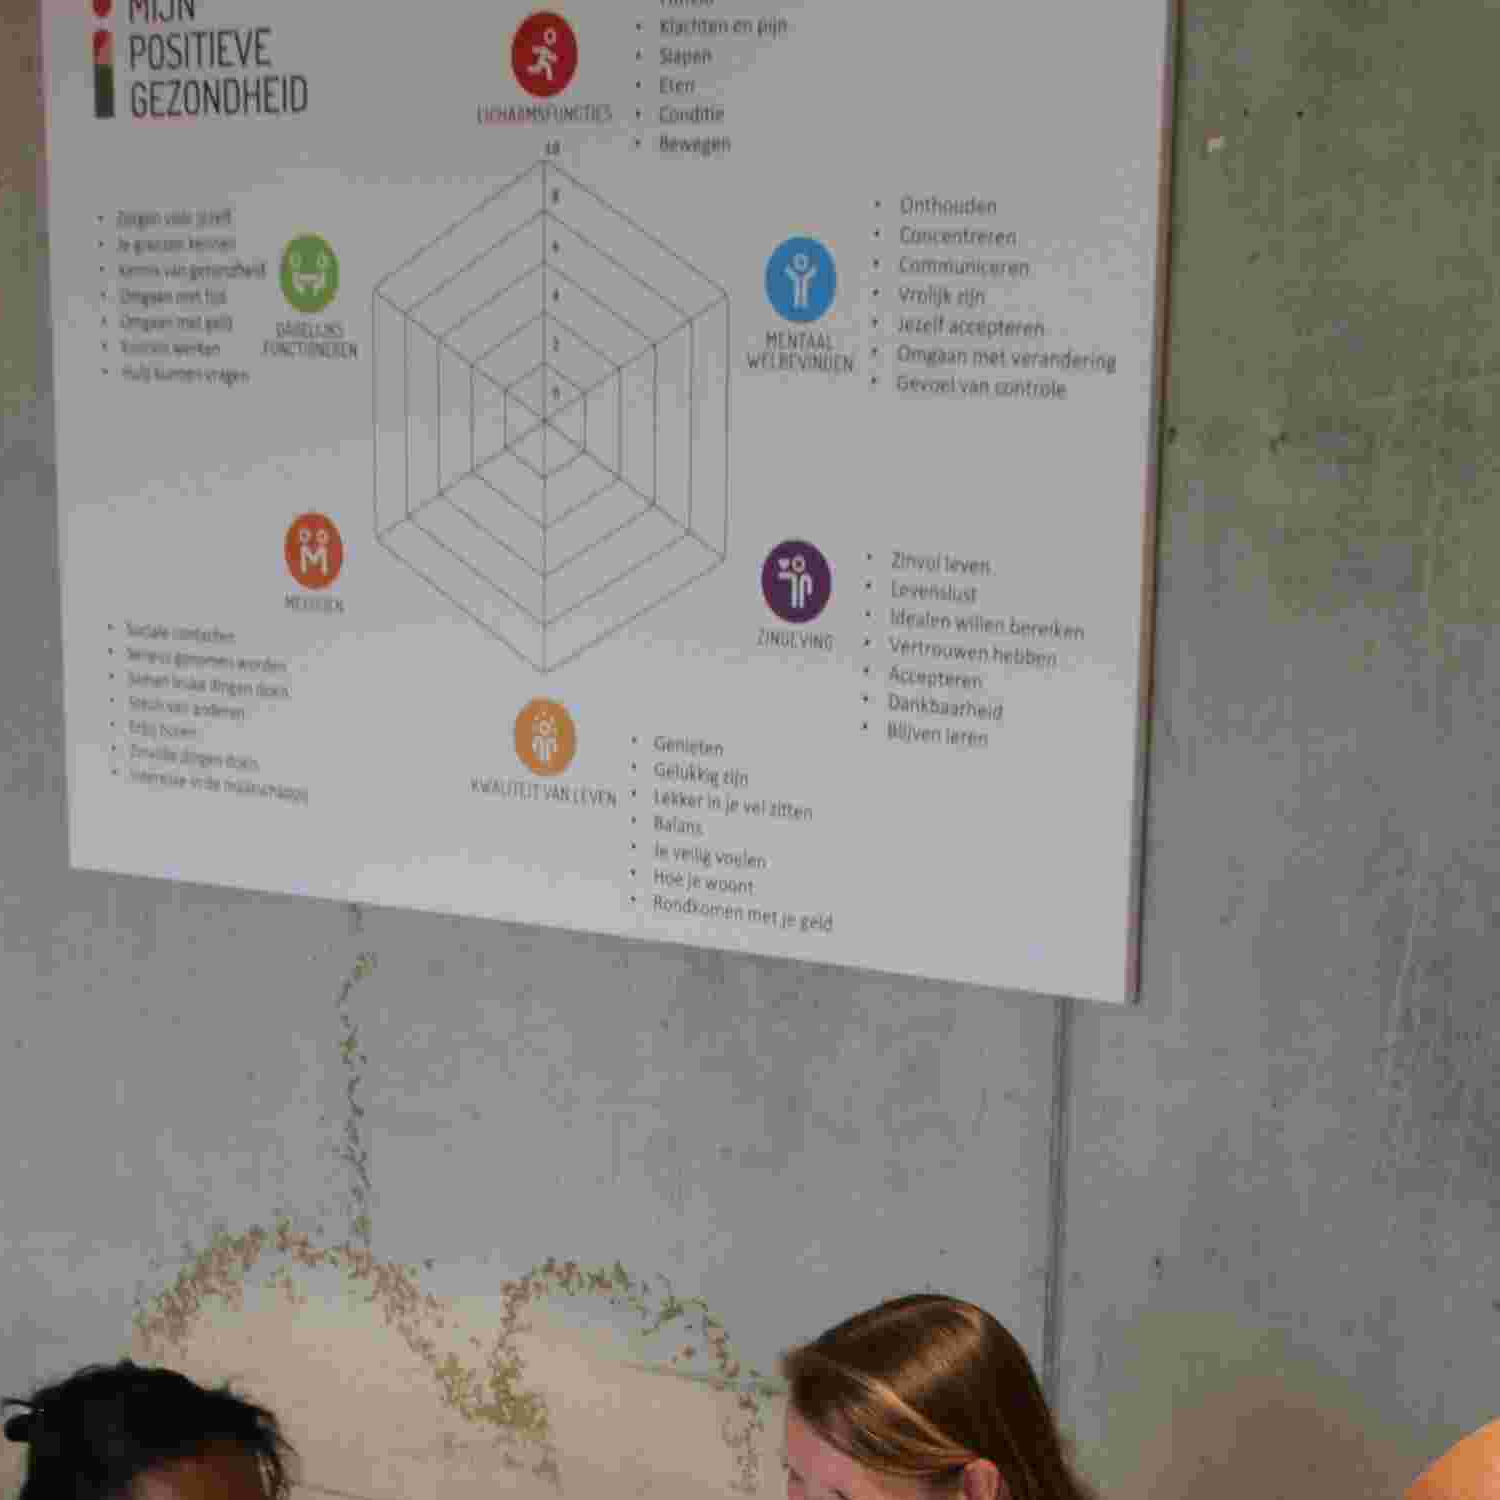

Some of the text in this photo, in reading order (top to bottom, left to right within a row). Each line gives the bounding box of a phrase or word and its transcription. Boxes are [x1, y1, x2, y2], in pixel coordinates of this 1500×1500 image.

[127, 0, 196, 23] MIJN
[660, 17, 788, 38] Klachten en pijn
[129, 28, 272, 71] POSITIEVE
[660, 48, 713, 67] Slapen
[131, 75, 308, 118] GEZONDHEID
[660, 77, 696, 94] Eten
[660, 105, 724, 123] Conditie
[660, 135, 731, 157] Bewegen
[900, 197, 997, 216] Onthouden
[900, 226, 1016, 247] Concentreren
[900, 256, 1029, 277] Communiceren
[900, 286, 985, 307] Vrolijk zijn
[766, 331, 834, 350] MENTAAL
[949, 321, 1044, 340] accepteren
[747, 352, 853, 373] WELBEVINDEN
[897, 346, 1116, 374] Omgaan met verandering
[897, 376, 1067, 399] Gevoel van controle
[892, 552, 991, 576] Zinvol leven
[892, 581, 977, 603] Levenslust
[891, 609, 1084, 641] Idealen willen bereiken
[757, 629, 833, 651] ZINGEVING
[889, 636, 1057, 667] Vertrouwen hebben
[889, 667, 982, 689] Accepteren
[888, 693, 1003, 721] Dankbaarheid
[888, 721, 988, 745] Blijven leren
[653, 736, 724, 756] Genieten
[653, 762, 748, 789] Gelukkig zijn
[543, 784, 569, 801] VAN
[573, 787, 617, 806] LEVEN
[654, 788, 813, 821] Lekker in je vel zitten
[654, 815, 703, 836] Balans
[673, 842, 711, 865] veilig
[715, 847, 766, 869] voelen
[653, 868, 754, 895] Hoe je woont
[652, 894, 834, 932] Rondkomen met je geld
